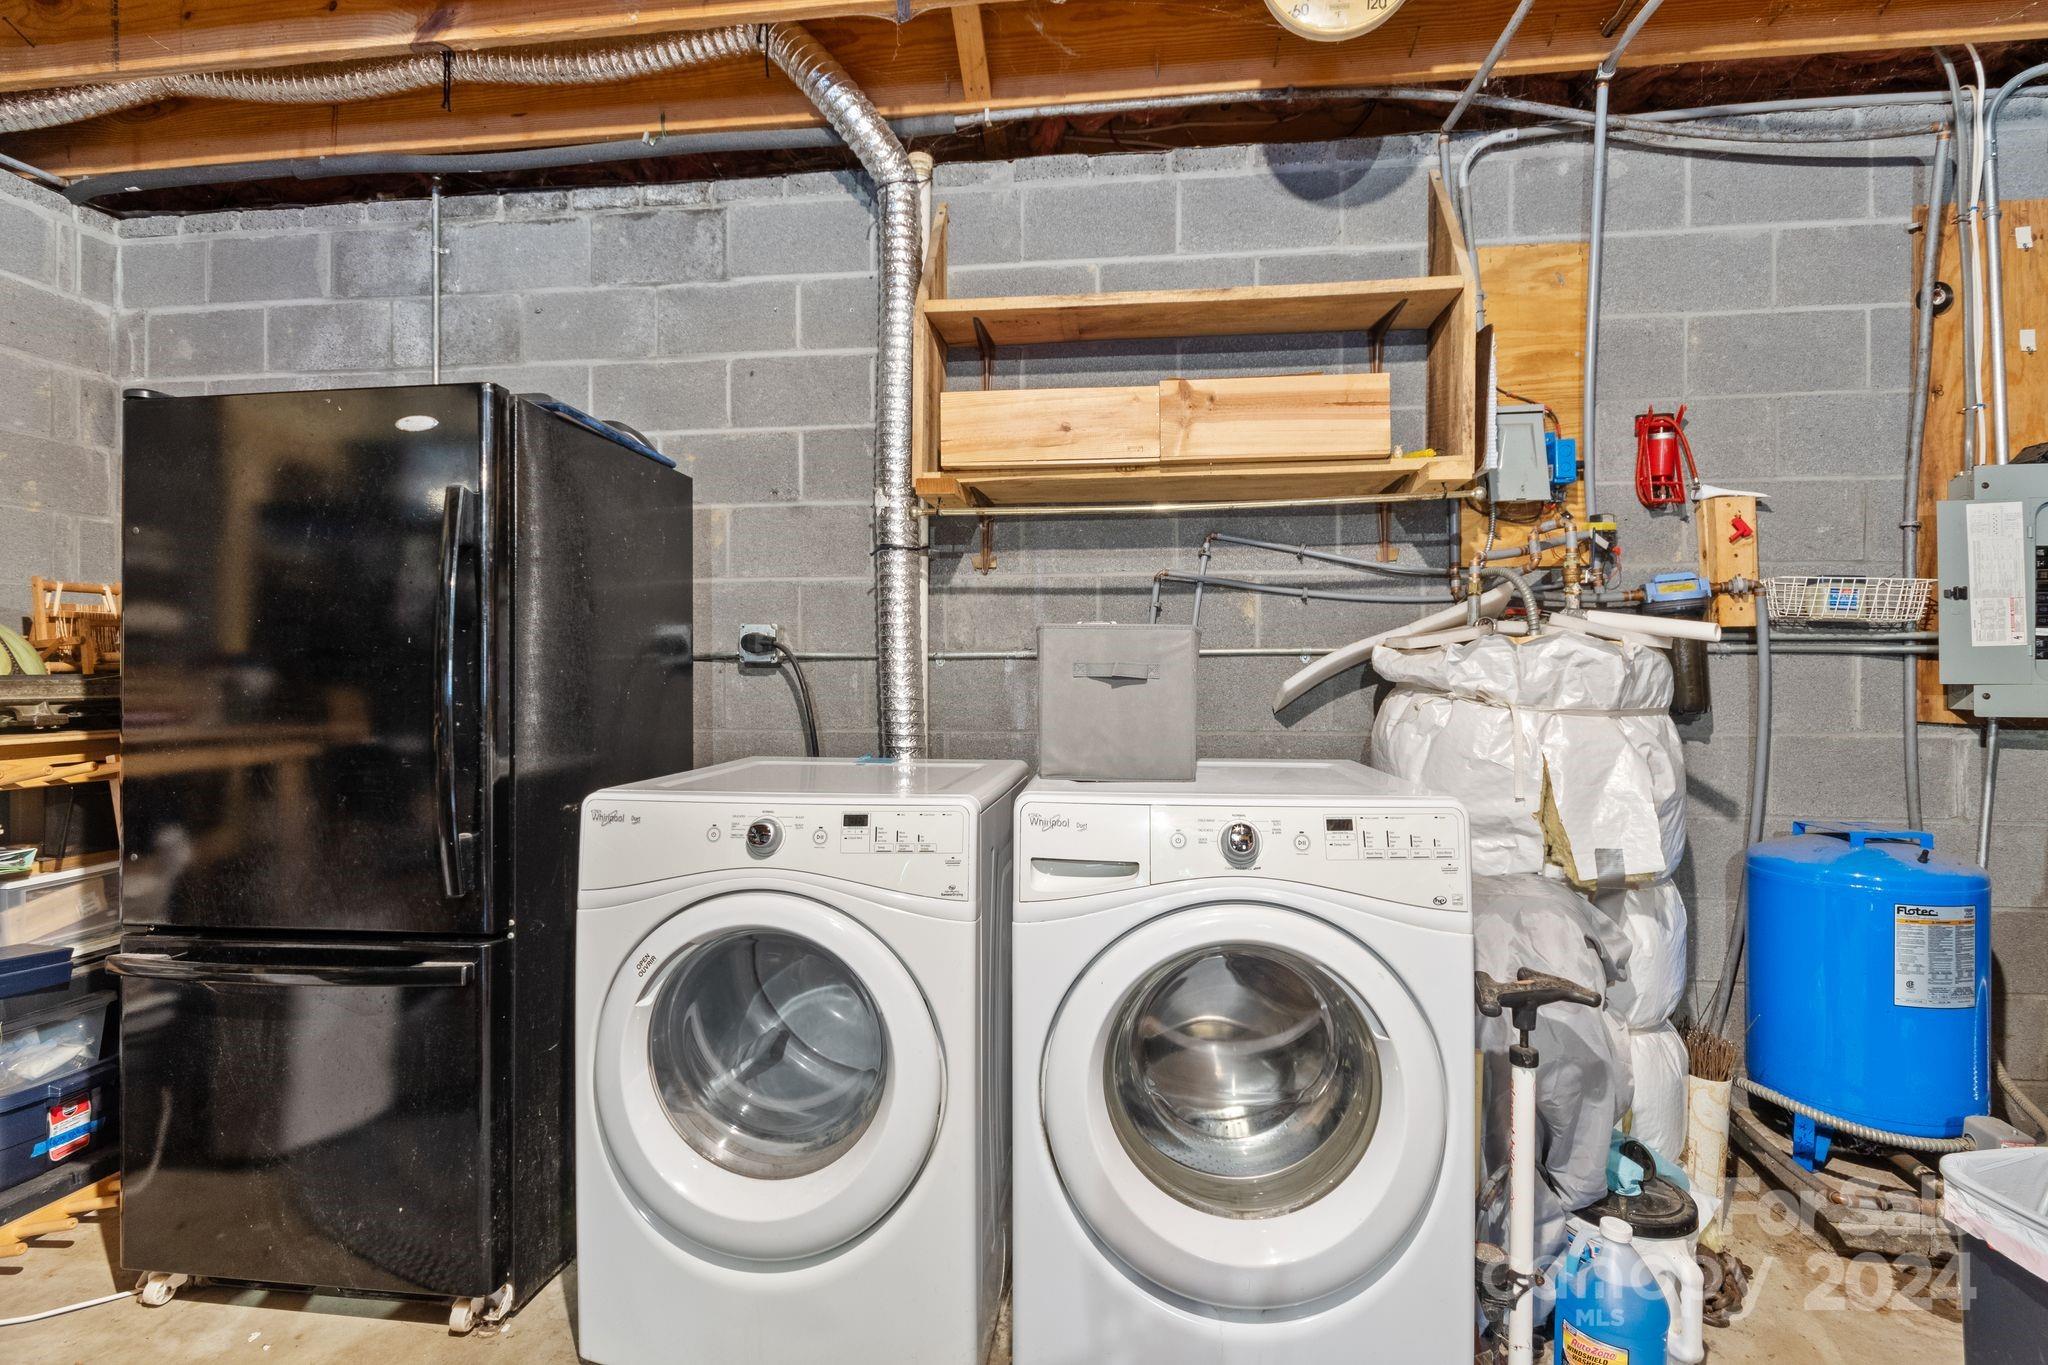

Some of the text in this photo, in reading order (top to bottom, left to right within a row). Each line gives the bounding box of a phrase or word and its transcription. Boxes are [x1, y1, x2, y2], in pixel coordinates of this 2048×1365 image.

[1291, 3, 1309, 18] 60
[591, 809, 625, 827] Whirlpool
[1028, 812, 1070, 832] Whirlpool
[1896, 906, 1938, 917] Flotec
[636, 953, 650, 970] OPEN
[638, 955, 657, 978] OUVRIR
[1566, 1344, 1609, 1365] WINDSHIELD
[1570, 1338, 1617, 1360] AutoZone
